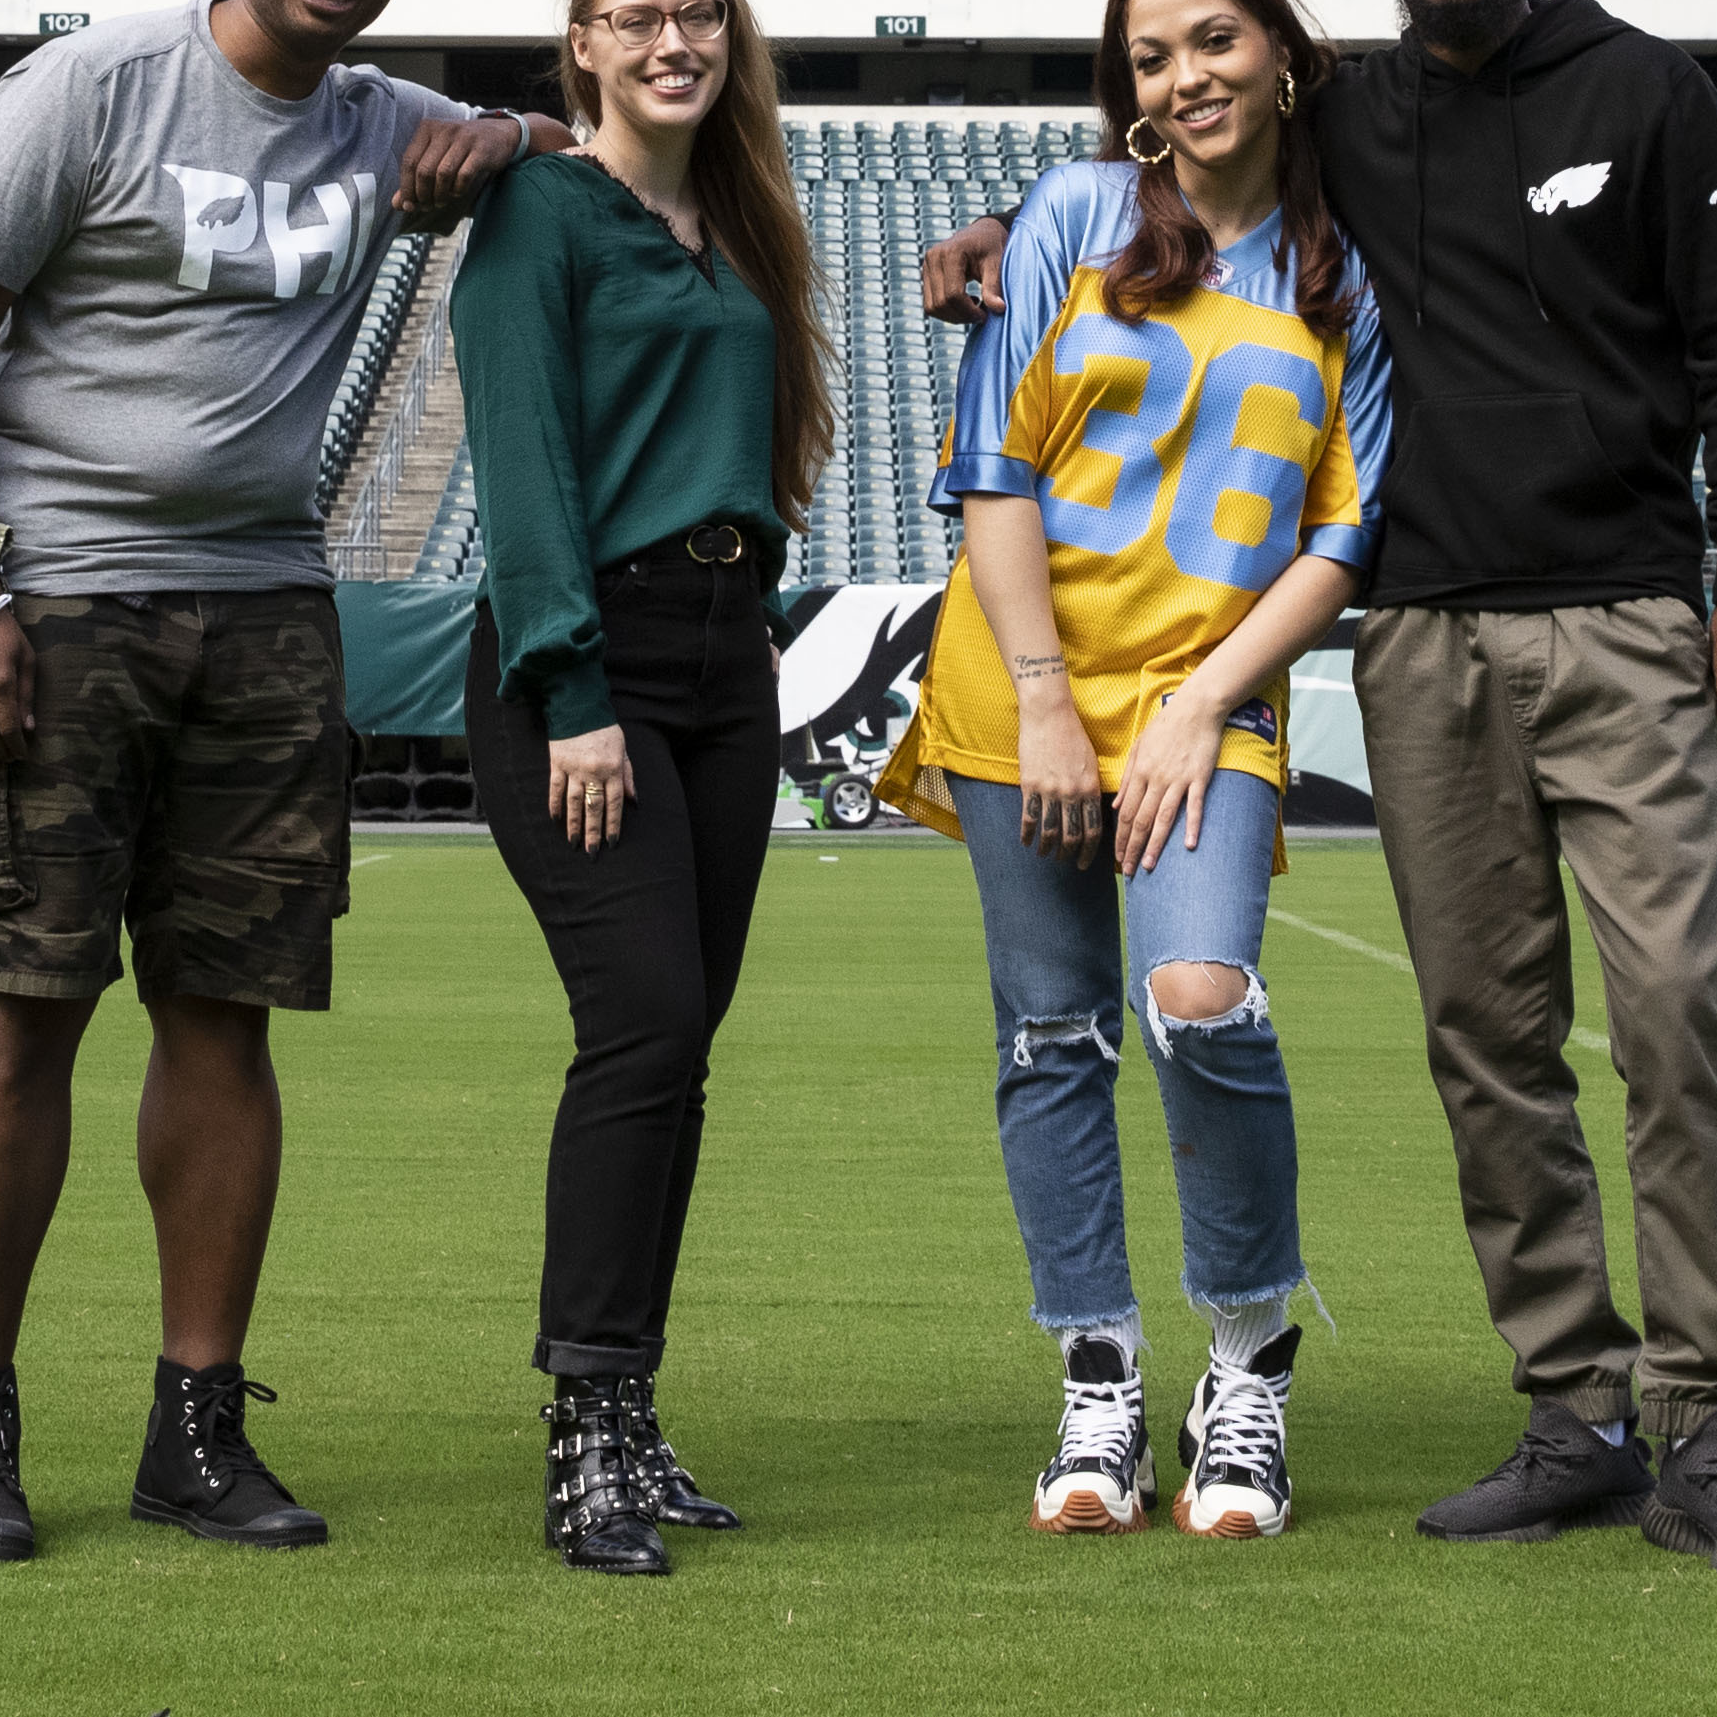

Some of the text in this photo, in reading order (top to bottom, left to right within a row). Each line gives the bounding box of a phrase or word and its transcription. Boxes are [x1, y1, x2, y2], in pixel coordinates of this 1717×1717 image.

[44, 14, 85, 32] 102
[884, 17, 918, 35] 101
[1037, 313, 1328, 592] 36
